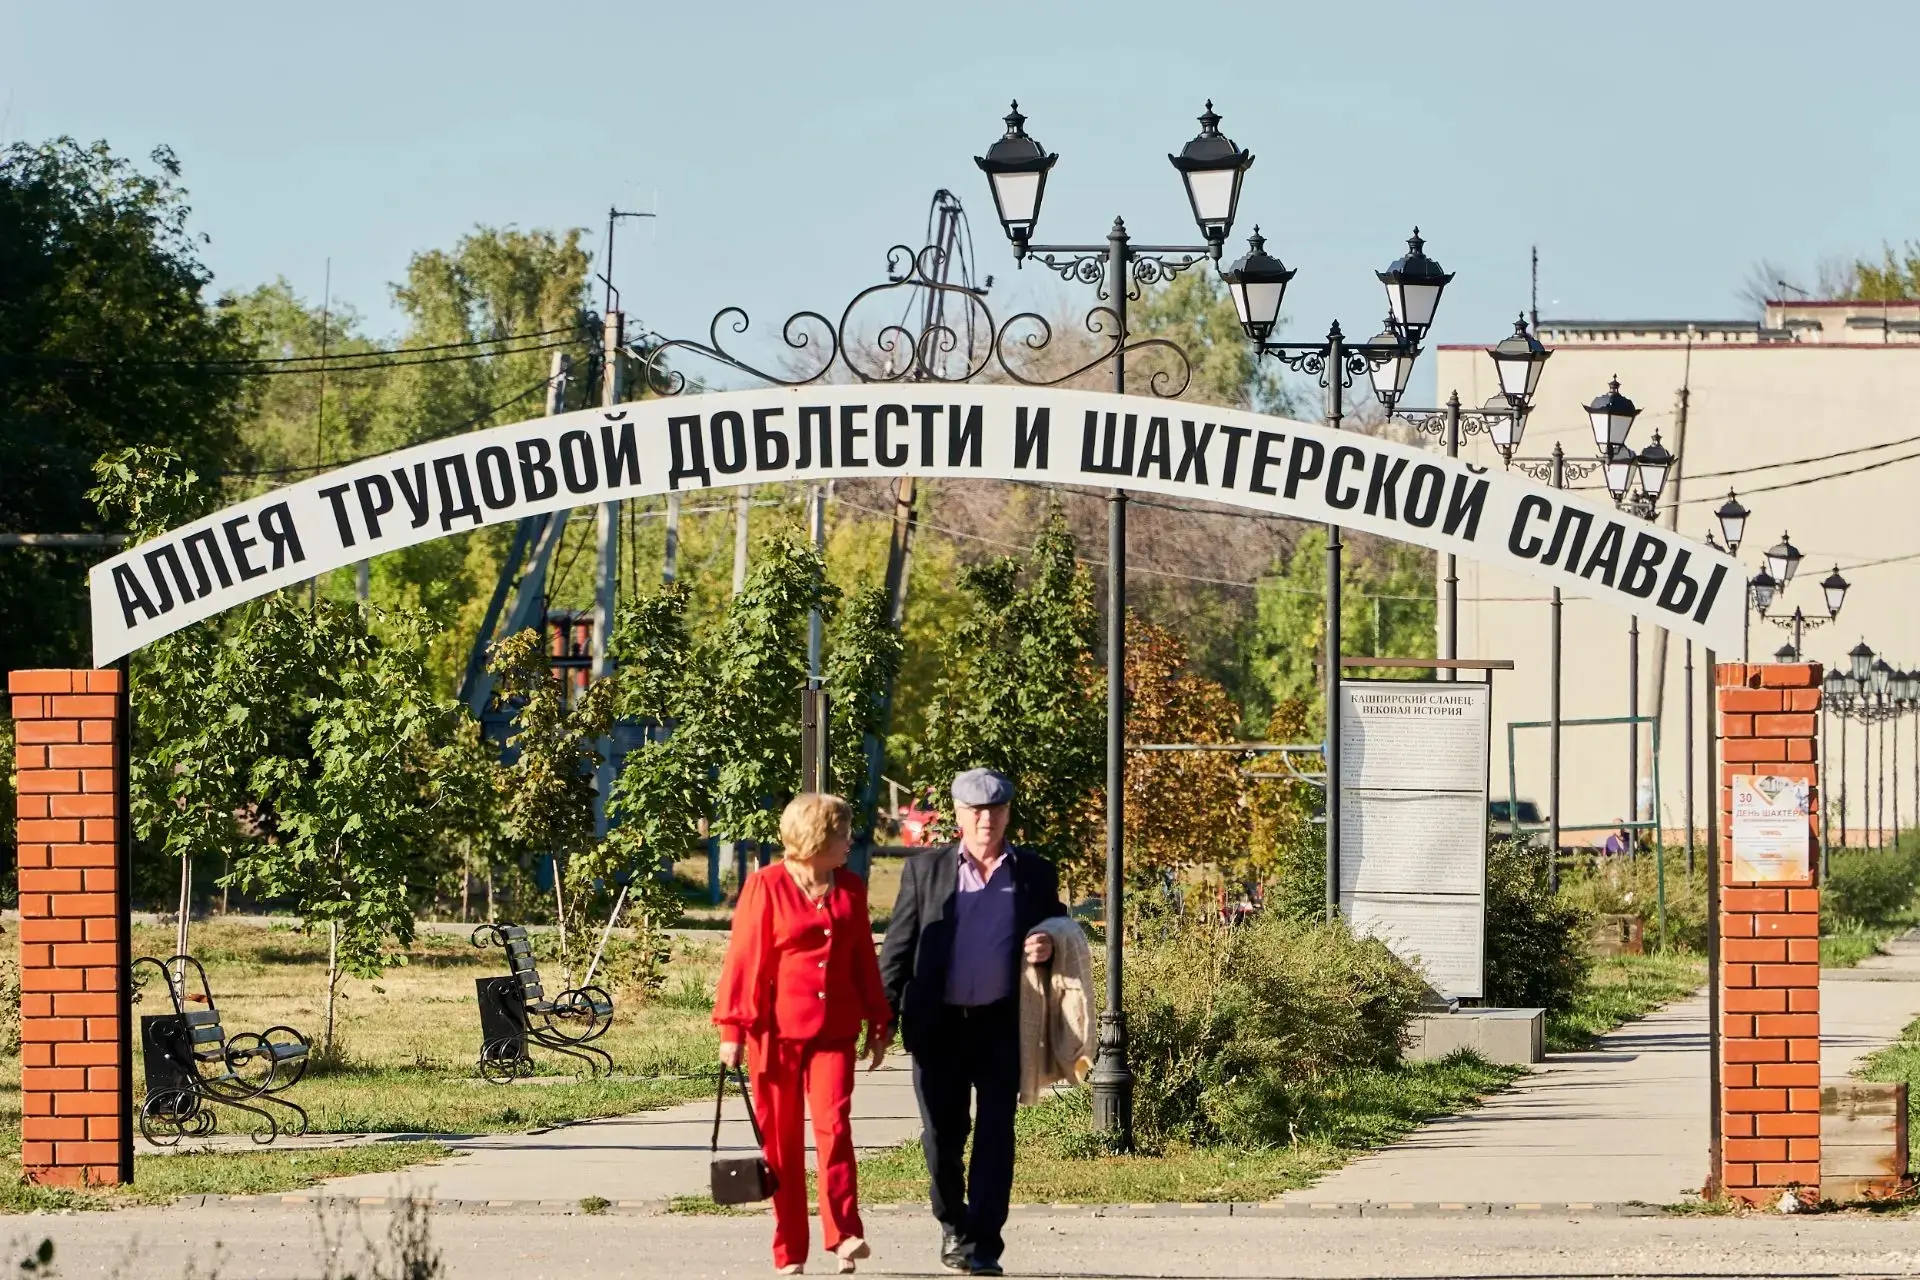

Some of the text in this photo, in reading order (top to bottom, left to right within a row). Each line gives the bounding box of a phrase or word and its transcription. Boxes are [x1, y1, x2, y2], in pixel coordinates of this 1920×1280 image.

[111, 404, 1728, 629] АЛЛЕЯ ТРУДОВОЙ ДОБЛЕСТИ И ШАХТЕРСКОЙ СЛАВЫ
[1351, 692, 1474, 706] КАШПИРСКИЙ СЛАНЕЦ:
[1362, 706, 1462, 716] ВЕКОВАЯ ИСТОРИЯ
[1739, 793, 1752, 803] 30
[1736, 809, 1760, 817] ДЕНЬ
